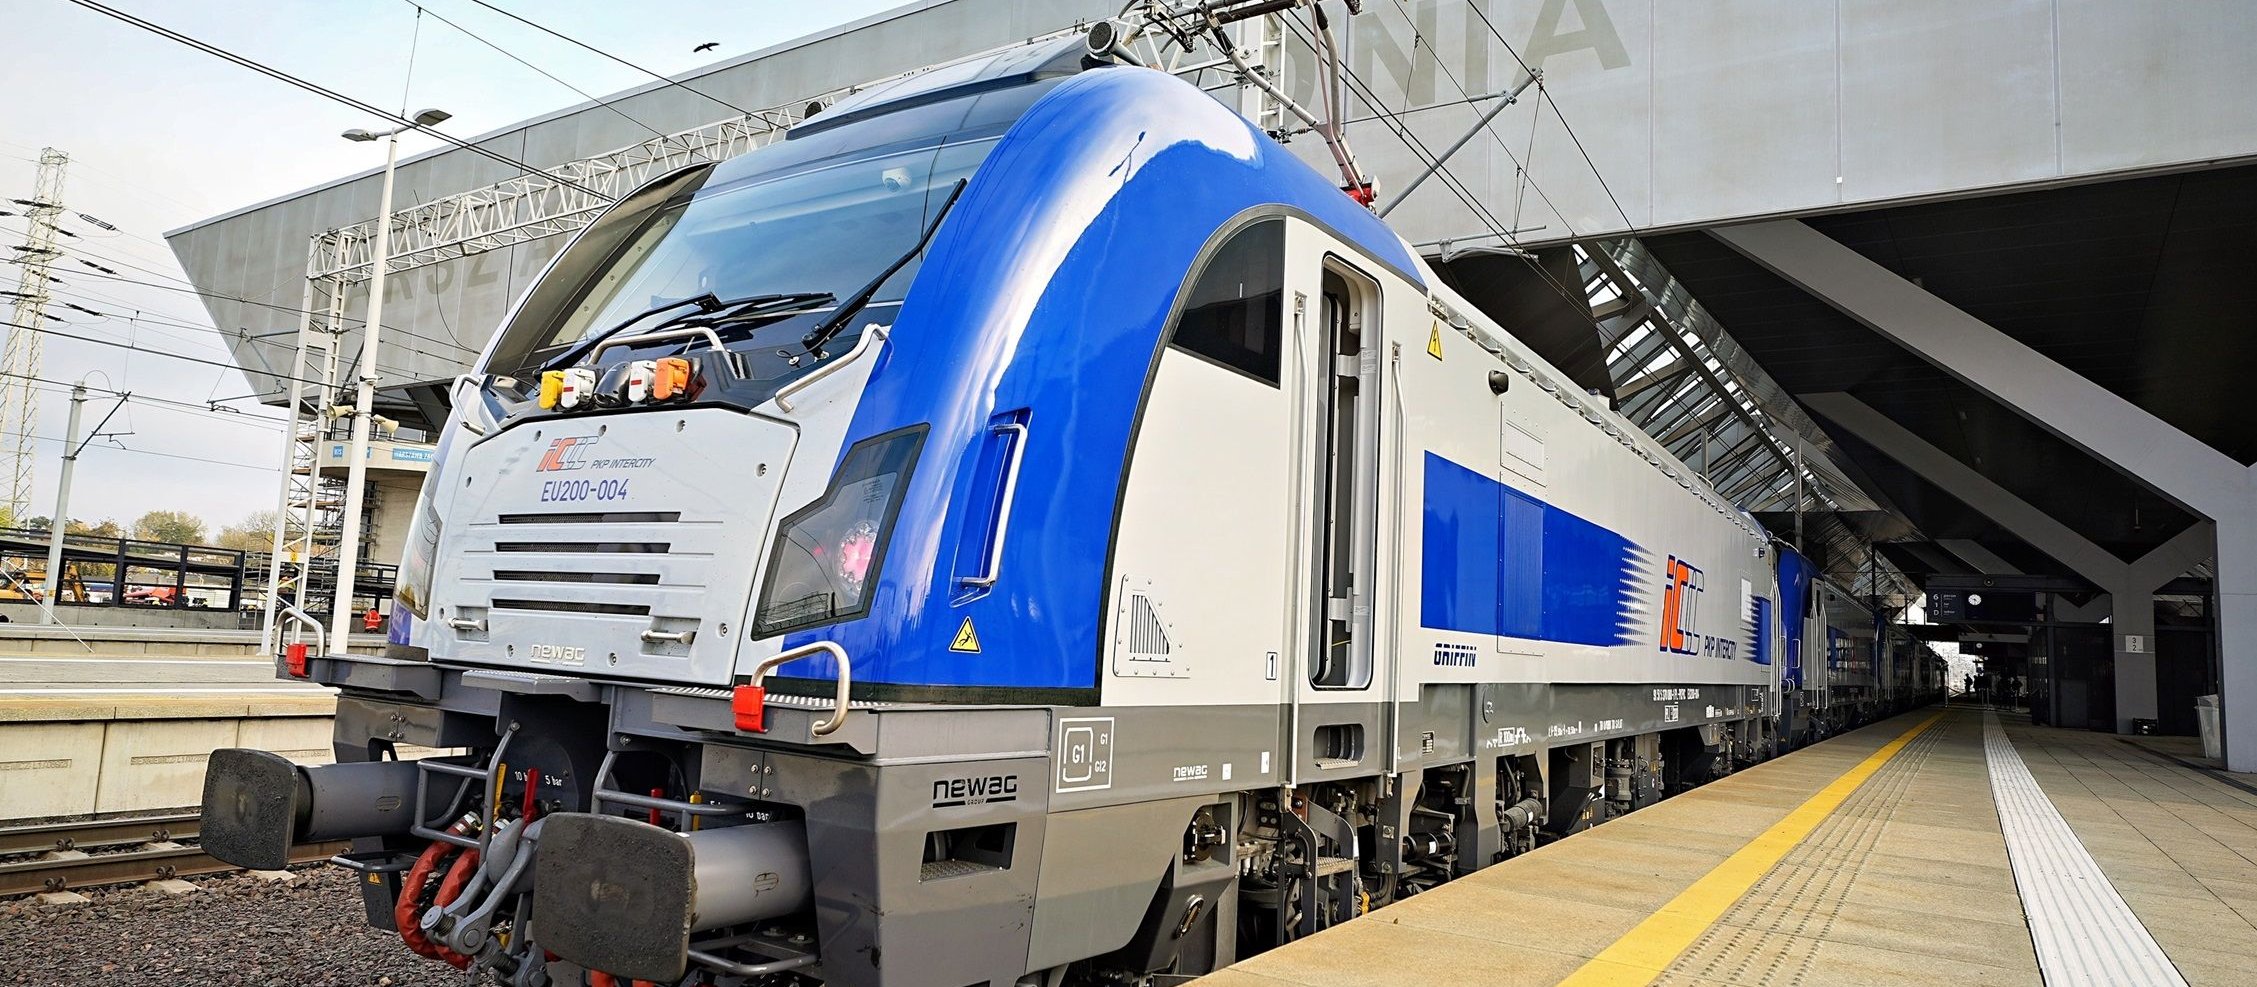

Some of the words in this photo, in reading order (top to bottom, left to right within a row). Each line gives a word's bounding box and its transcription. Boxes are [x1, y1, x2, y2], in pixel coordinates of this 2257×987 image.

[590, 460, 609, 470] PKP
[609, 458, 656, 469] INTERCITY
[541, 478, 629, 502] EU200-004
[2132, 636, 2137, 644] 3
[2132, 644, 2137, 652] 2
[1433, 643, 1477, 668] GRIFFIN
[1269, 654, 1275, 678] 1
[1100, 732, 1108, 745] G1
[1072, 744, 1085, 764] G1
[514, 771, 523, 781] 10
[544, 775, 551, 785] 5
[551, 775, 563, 787] bar
